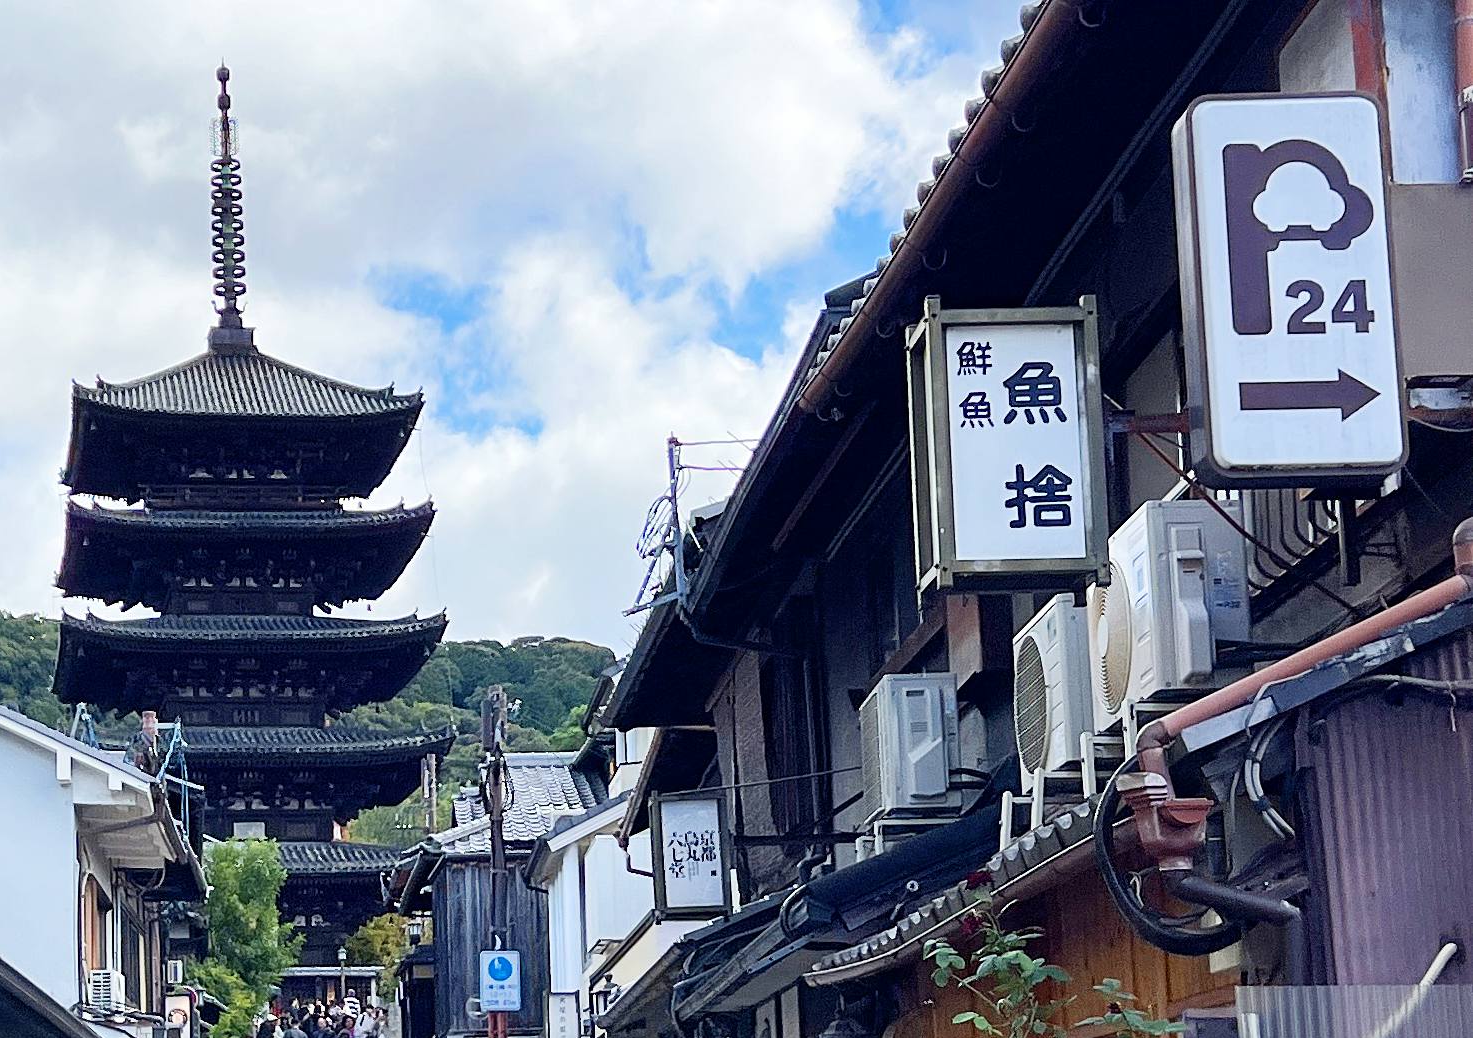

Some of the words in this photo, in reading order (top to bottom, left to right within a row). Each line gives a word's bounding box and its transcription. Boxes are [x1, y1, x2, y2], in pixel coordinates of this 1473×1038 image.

[1285, 279, 1375, 335] 24
[955, 341, 994, 429] 鮮魚
[1002, 361, 1073, 529] 魚捨
